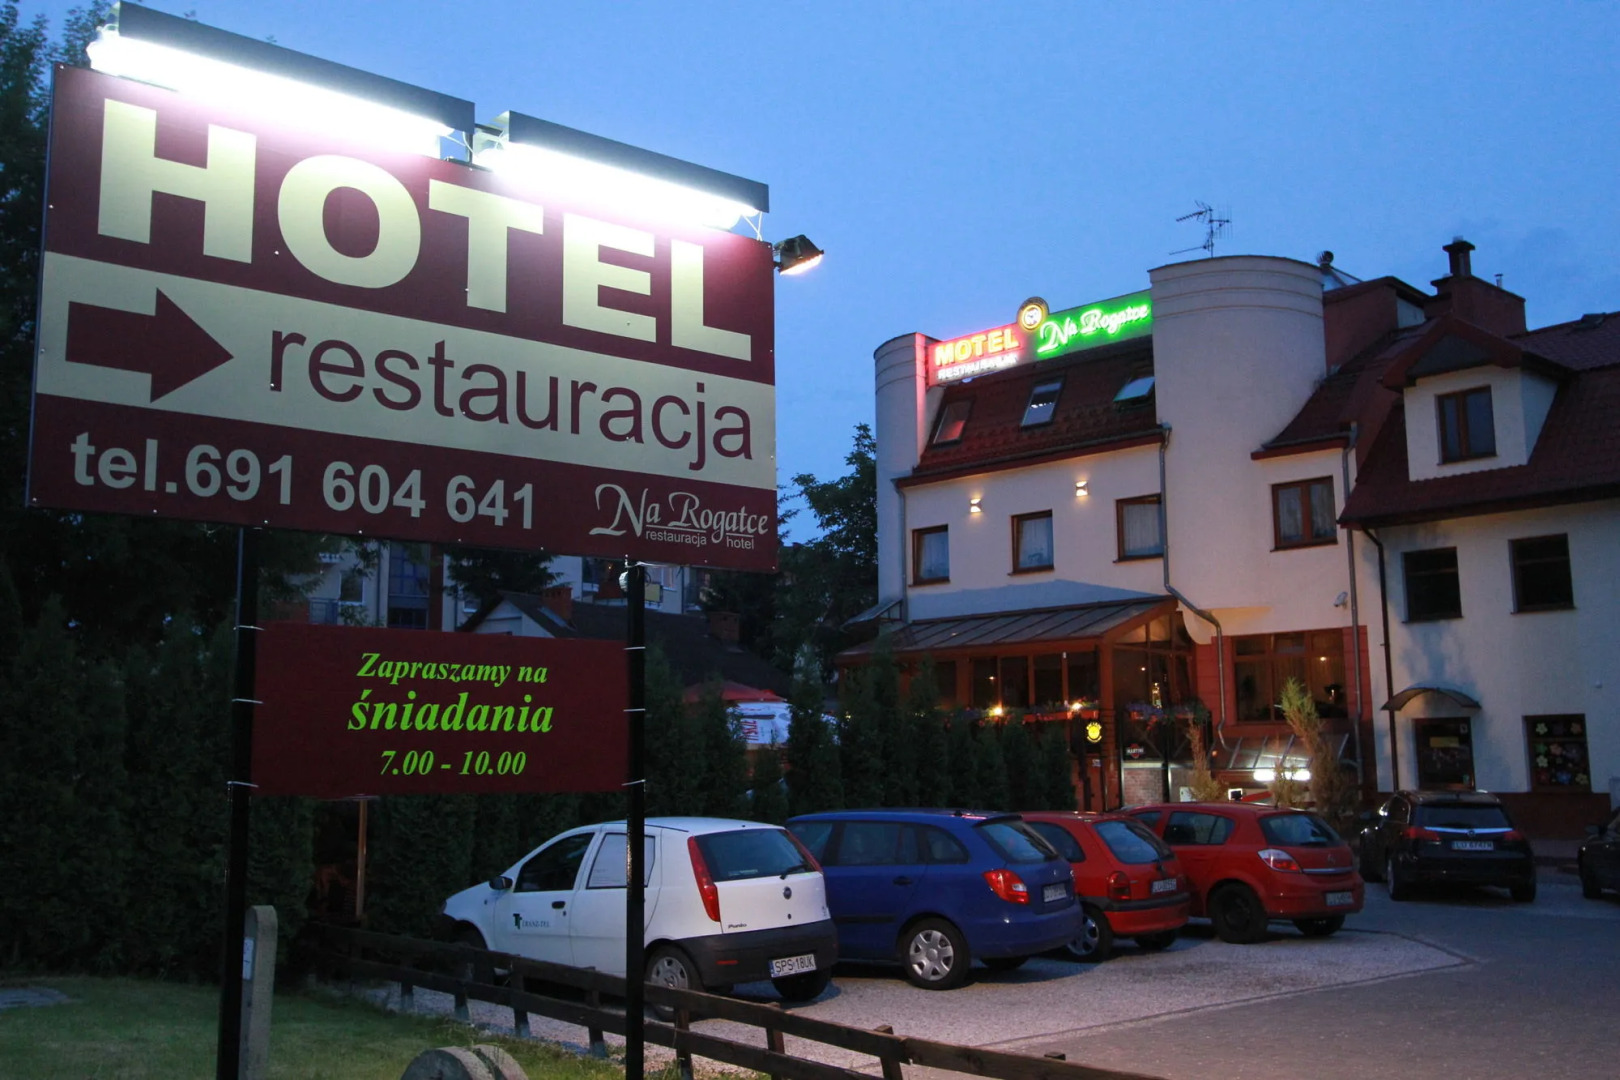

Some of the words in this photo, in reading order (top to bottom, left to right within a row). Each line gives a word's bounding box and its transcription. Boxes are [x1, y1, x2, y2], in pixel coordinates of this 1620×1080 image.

[98, 97, 752, 362] HOTEL
[935, 328, 1020, 366] MOTEL
[1037, 317, 1078, 353] Na
[1080, 305, 1148, 334] Rogatce
[269, 329, 753, 471] restauracja
[322, 460, 426, 518] 604
[445, 474, 534, 529] 641
[589, 483, 661, 537] Na
[667, 491, 769, 543] Rogatce
[645, 529, 707, 547] restauracja
[726, 537, 754, 549] hotel
[356, 652, 511, 687] Zapraszamy
[518, 665, 548, 683] na
[347, 689, 554, 733] śniadania
[380, 750, 434, 776] 7.00
[458, 751, 527, 776] 10.00
[775, 958, 794, 973] SPS
